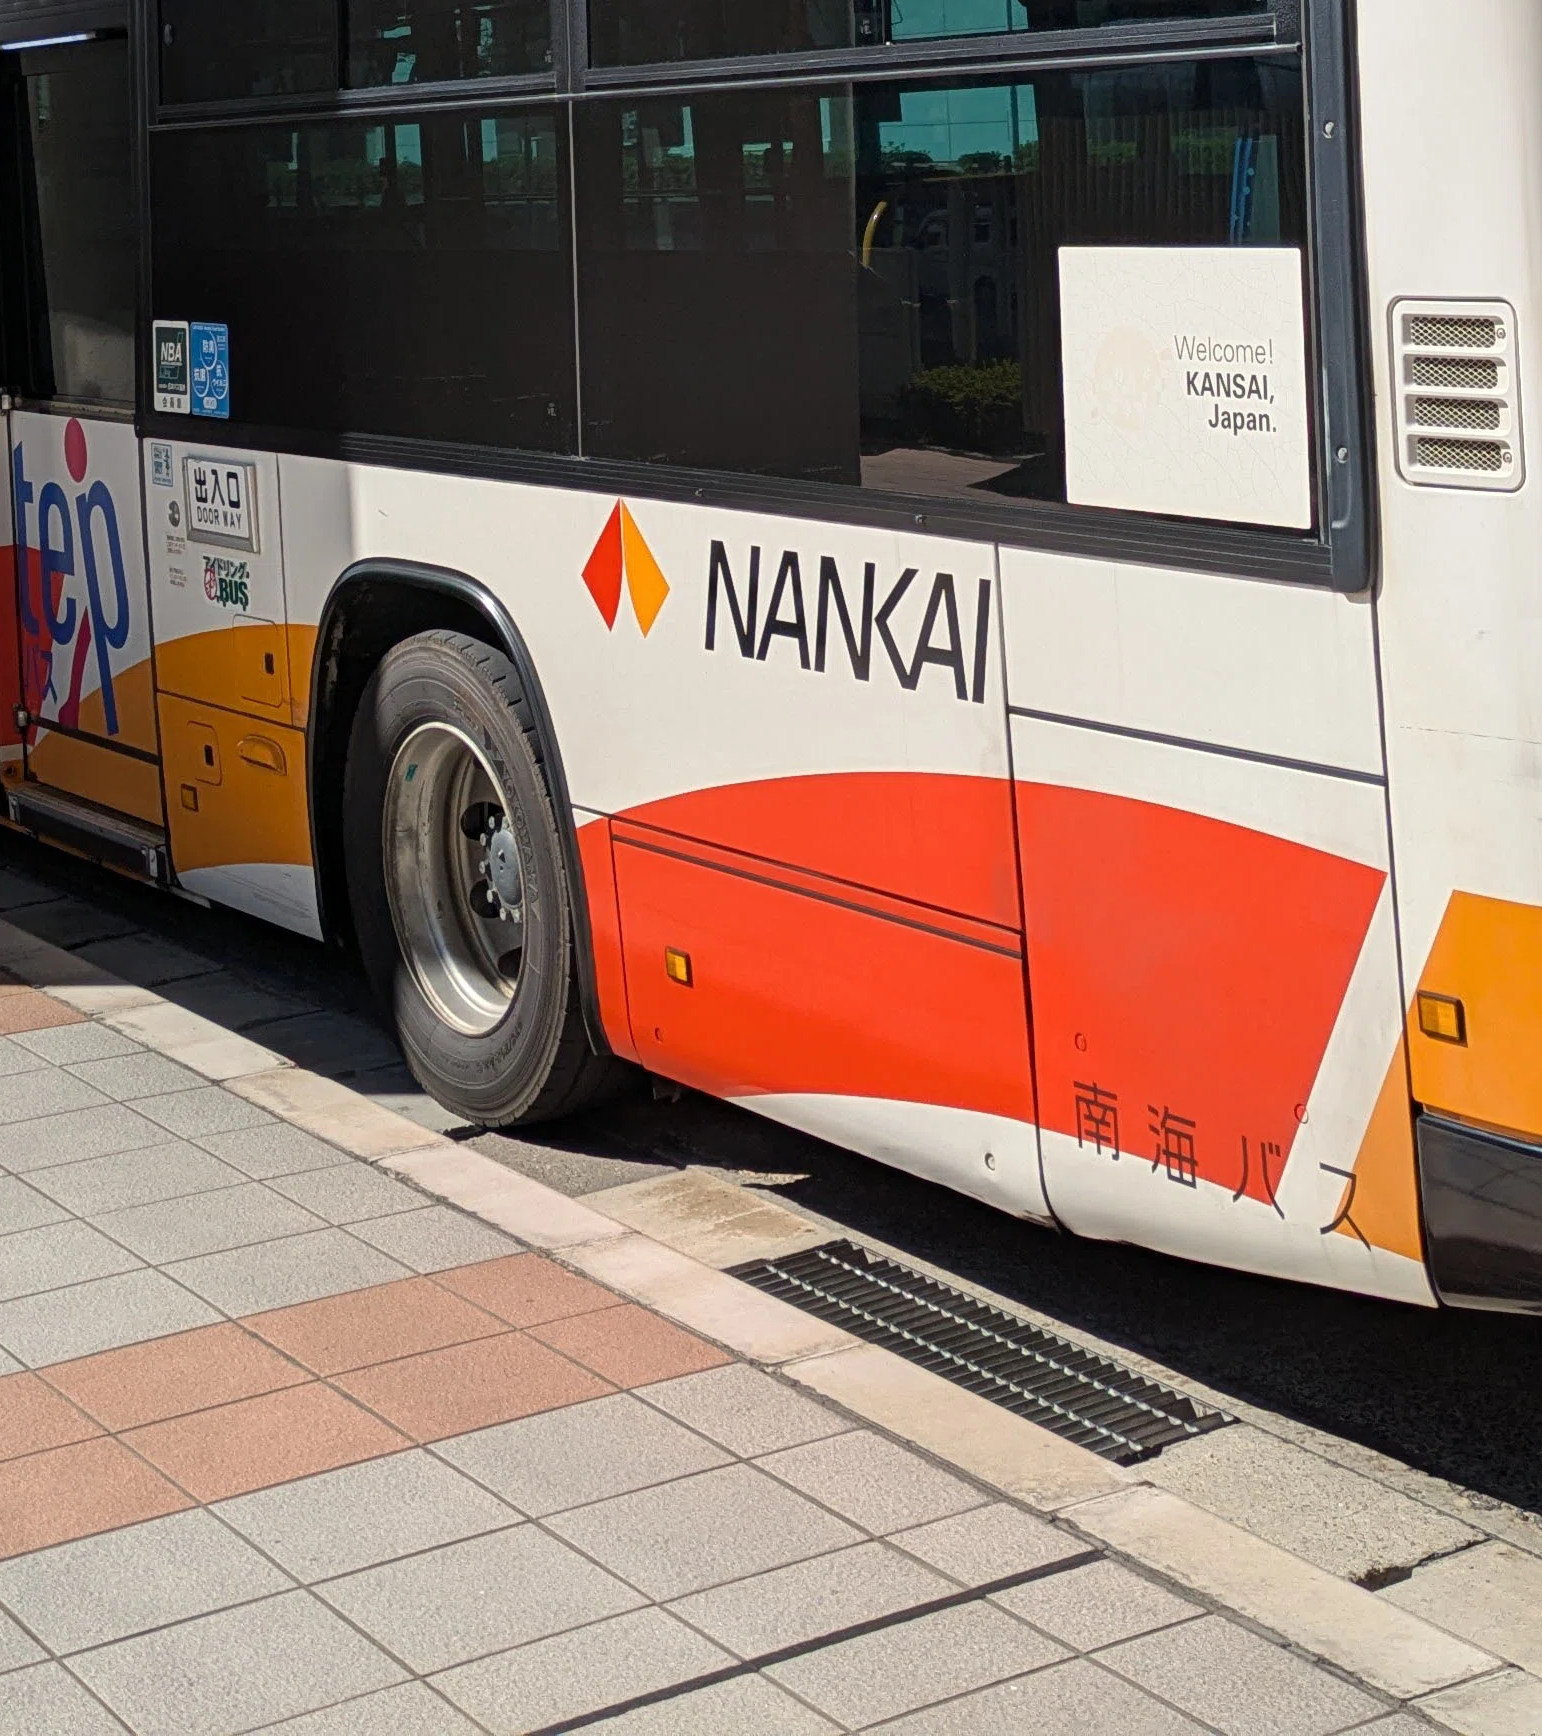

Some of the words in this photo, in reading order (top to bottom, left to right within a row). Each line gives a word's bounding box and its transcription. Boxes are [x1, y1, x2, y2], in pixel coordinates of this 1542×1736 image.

[160, 341, 183, 363] NBA
[1173, 334, 1274, 365] Welcome!
[1186, 370, 1275, 404] KANSAI,
[1208, 403, 1278, 436] Japan.
[193, 466, 241, 510] 出入口
[196, 505, 221, 526] DOOR
[222, 510, 242, 530] WAY
[218, 577, 249, 607] BUS
[704, 539, 991, 704] NANKAI
[1072, 1080, 1372, 1252] 南海バス
